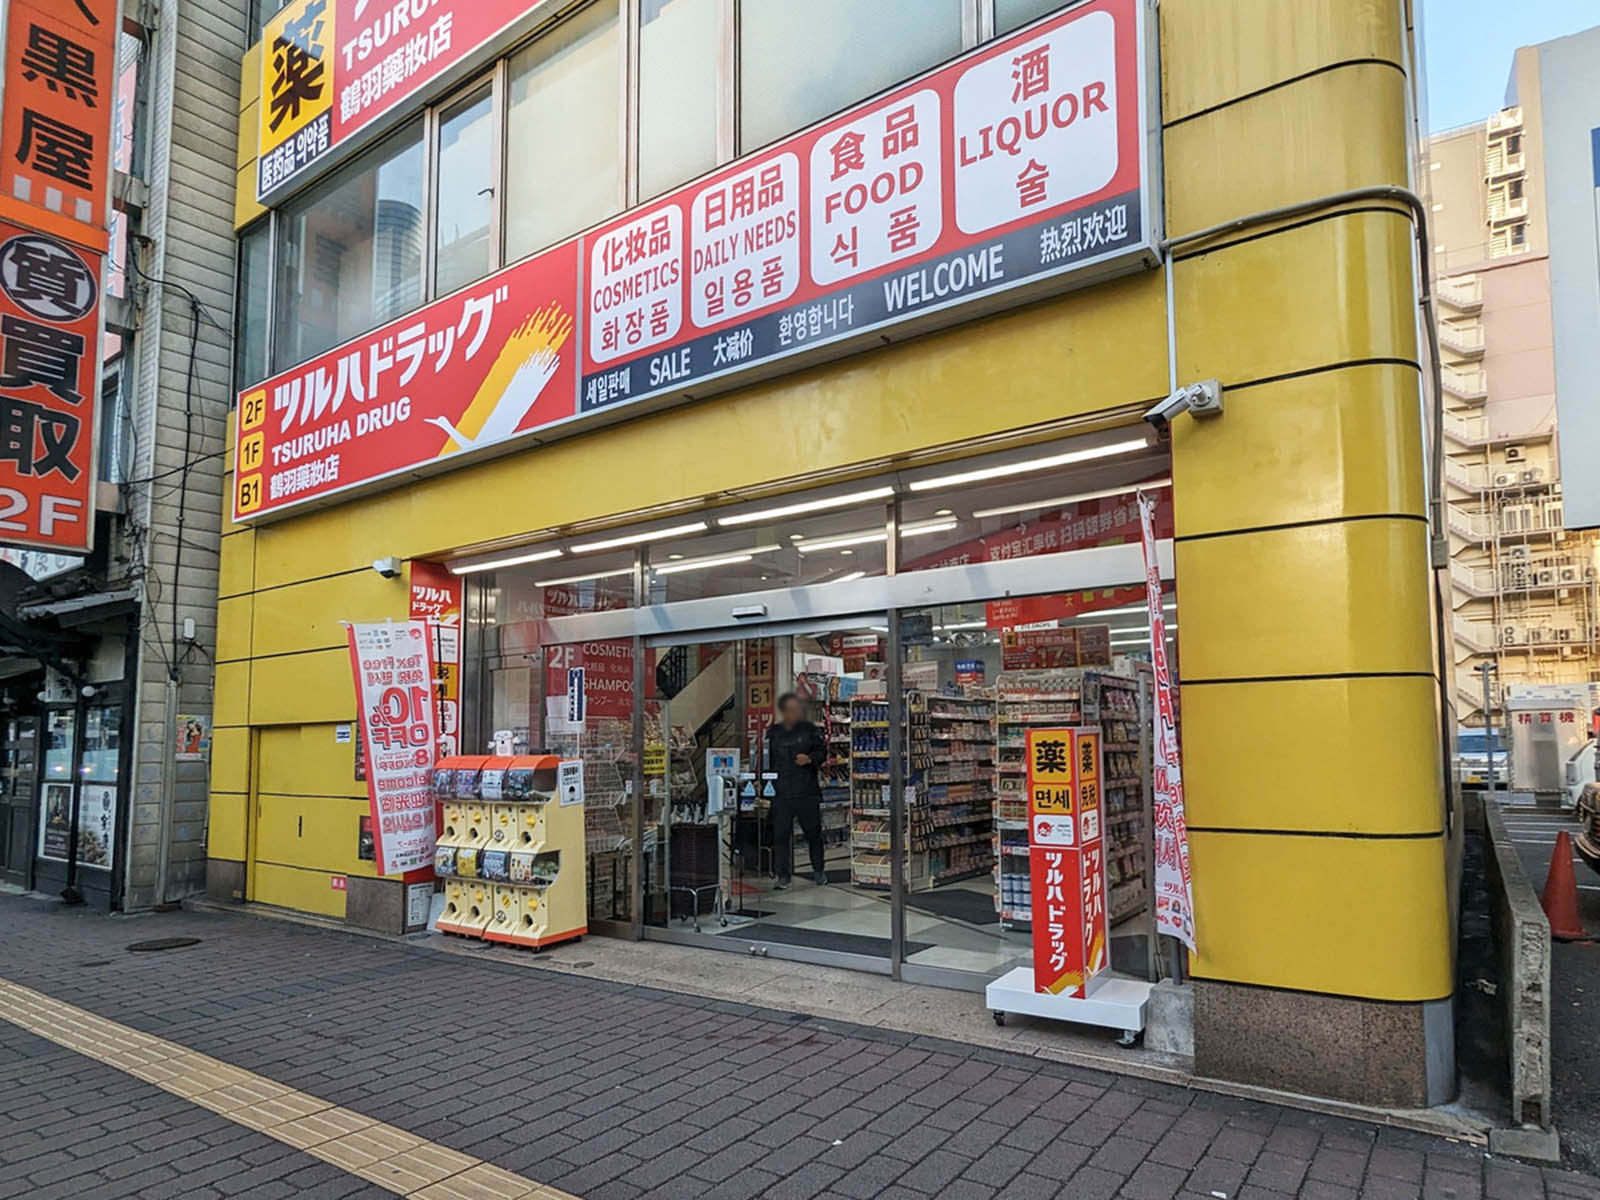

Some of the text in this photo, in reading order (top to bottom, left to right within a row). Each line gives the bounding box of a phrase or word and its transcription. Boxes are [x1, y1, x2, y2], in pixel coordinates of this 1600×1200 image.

[270, 0, 326, 134] 薬
[1010, 43, 1050, 104] 酒
[296, 113, 329, 163] 의약품
[830, 104, 919, 182] 食品
[960, 80, 1109, 168] LIQUOR
[705, 163, 784, 232] 日用品
[824, 161, 923, 224] FOOD
[1015, 158, 1049, 208] 술
[602, 214, 671, 276] 化妆品
[694, 210, 796, 275] DAILY NEEDS
[586, 368, 631, 405] 세일판매
[649, 348, 691, 386] SALE
[778, 294, 854, 347] 환영합니다
[884, 244, 1004, 312] WELCOME
[1040, 204, 1128, 265] 热烈欢迎
[593, 258, 679, 313] COSMETICS
[704, 256, 785, 317] 일용품
[601, 299, 670, 351] 화장품
[273, 285, 508, 433] ツルハドラッグ
[245, 399, 263, 424] 2F
[272, 396, 411, 467] TSURUHA DRUG
[244, 441, 260, 464] 1F
[0, 487, 82, 537] 2F
[241, 480, 258, 506] B1
[412, 585, 452, 604] ツルハ
[549, 646, 574, 668] 2F
[751, 660, 769, 676] 1F
[751, 688, 770, 705] B1
[1035, 740, 1067, 773] 薬
[1036, 789, 1070, 809] 면세
[1045, 852, 1068, 972] ツルハドラッグ
[1083, 849, 1102, 947] ツルハ ドラッグ
